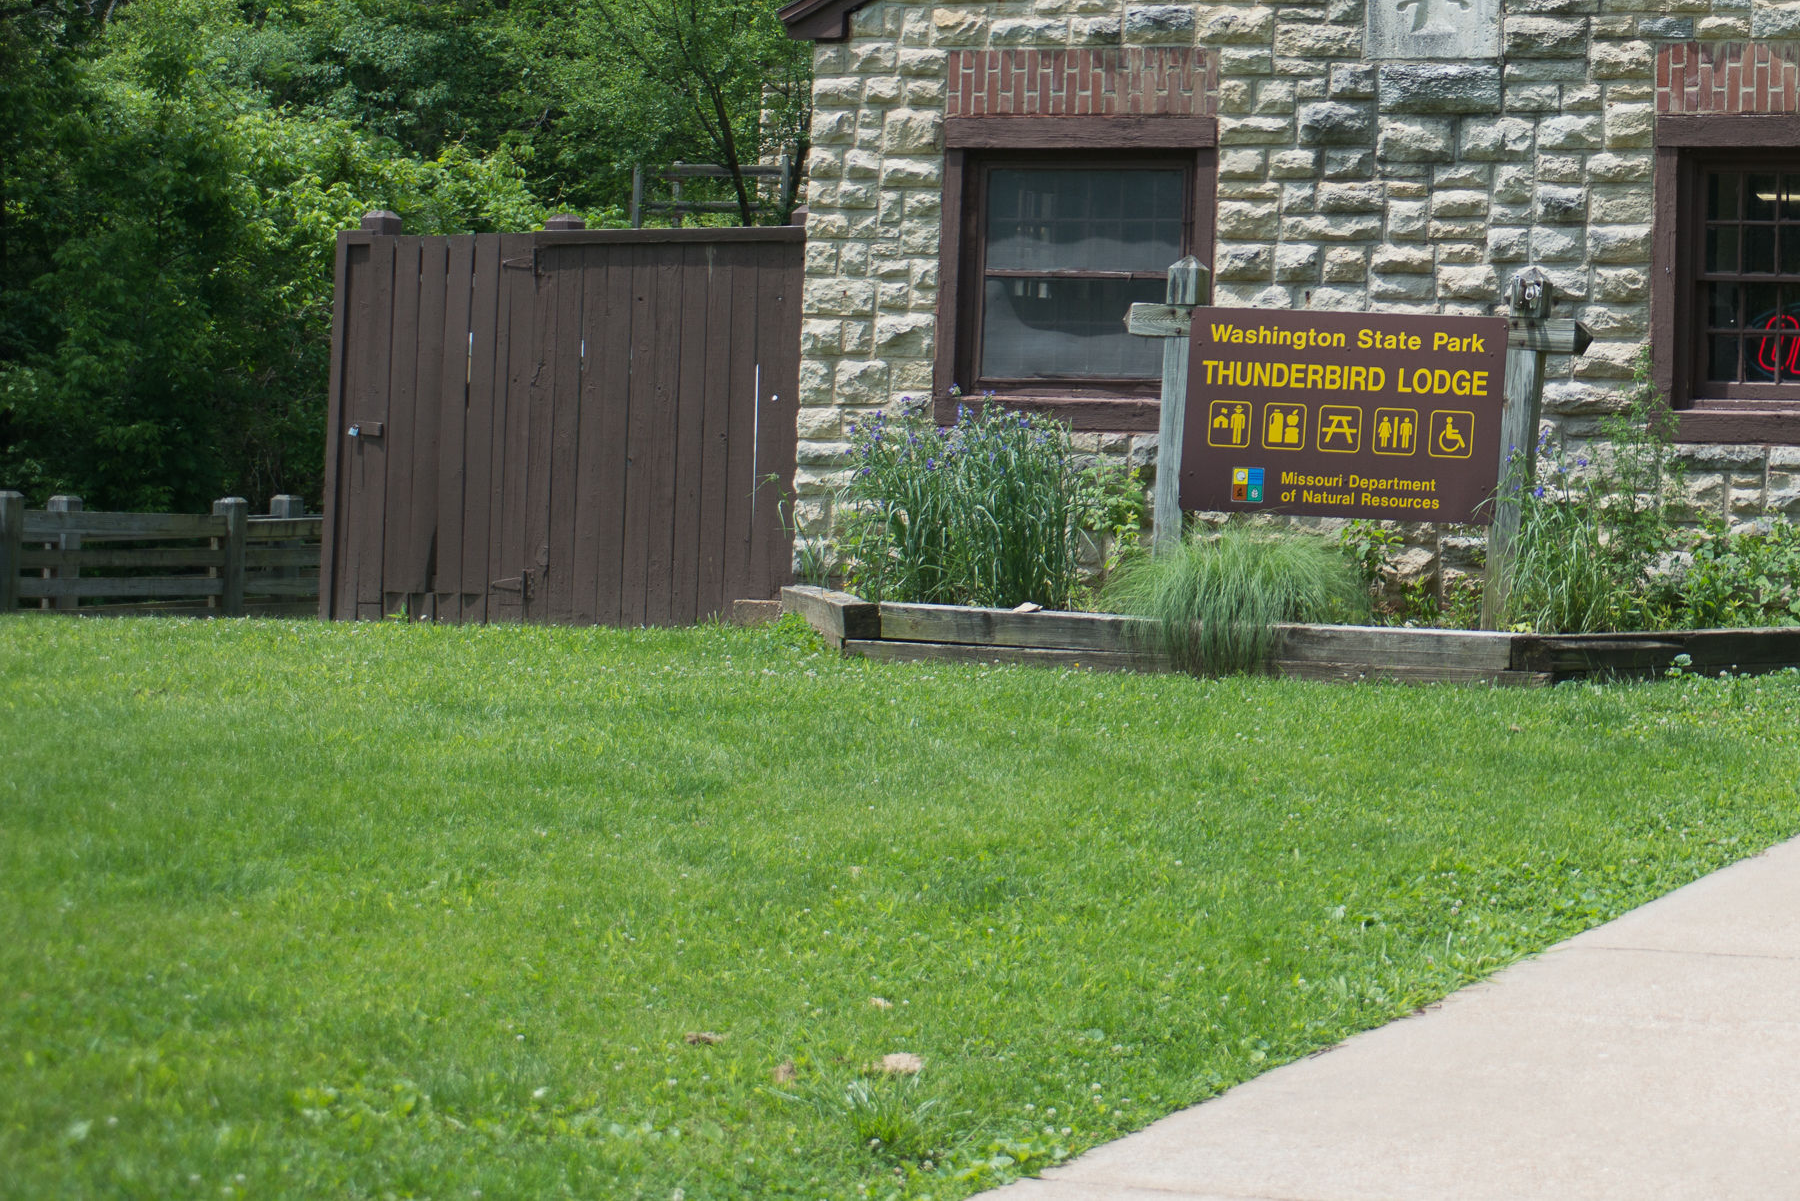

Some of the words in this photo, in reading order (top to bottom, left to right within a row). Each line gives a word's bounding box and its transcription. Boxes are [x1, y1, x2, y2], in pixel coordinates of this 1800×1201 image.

[1210, 323, 1346, 350] Washington
[1356, 328, 1422, 351] State
[1432, 331, 1485, 353] Park
[1202, 359, 1386, 392] THUNDERBIRD
[1397, 367, 1489, 396] LODGE
[1281, 471, 1343, 487] Missouri
[1348, 474, 1436, 492] Department
[1281, 489, 1297, 502] of
[1302, 489, 1355, 505] Natural
[1361, 492, 1440, 510] Resources
